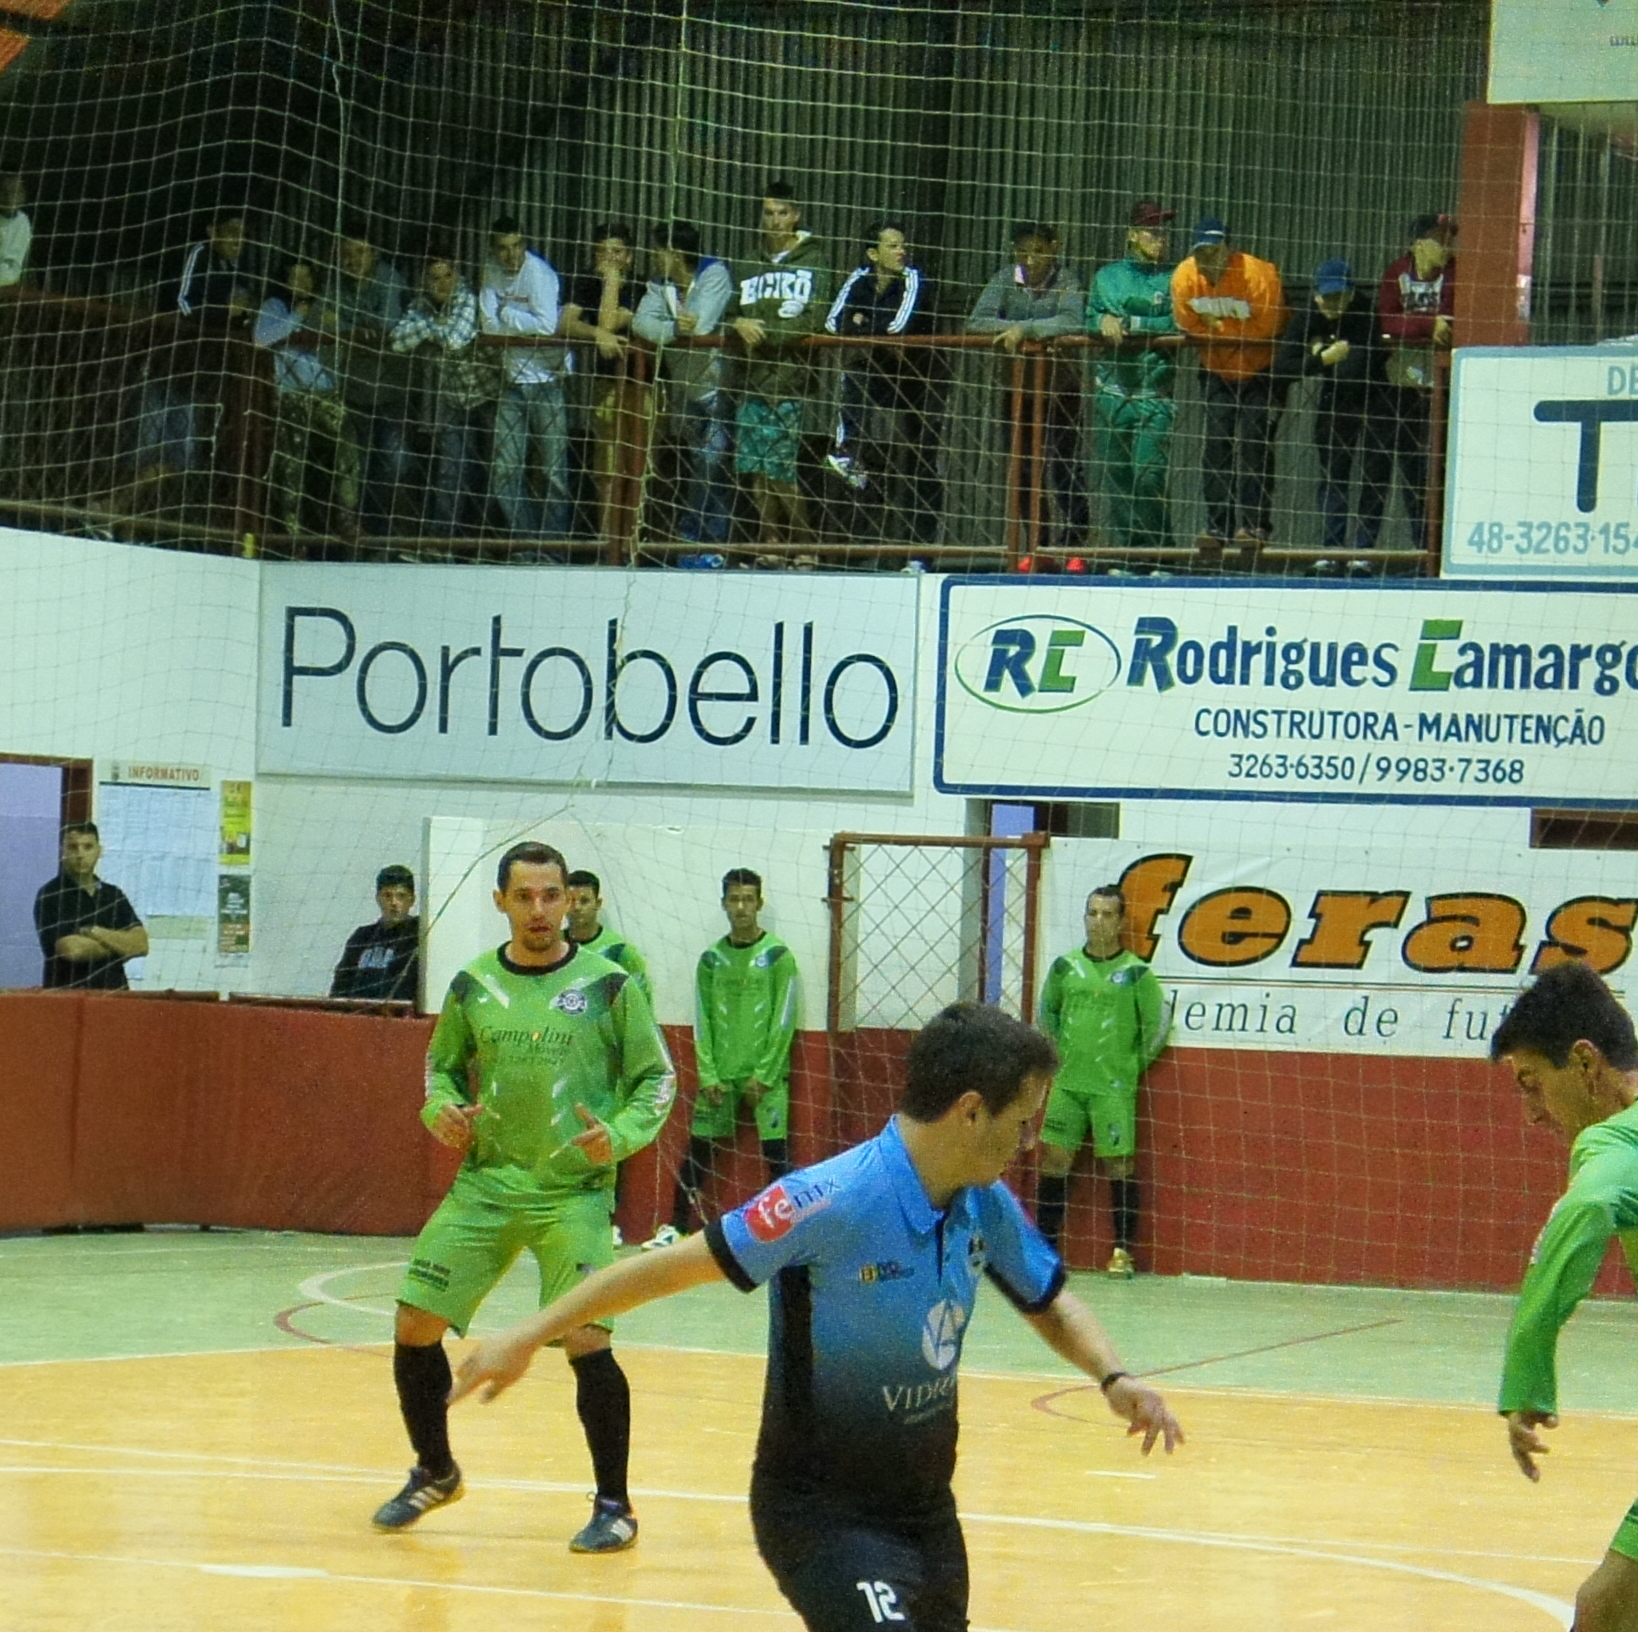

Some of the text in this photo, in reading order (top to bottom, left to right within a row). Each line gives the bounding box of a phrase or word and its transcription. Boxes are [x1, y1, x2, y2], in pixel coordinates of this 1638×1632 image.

[1127, 616, 1398, 693] Rodrigues
[278, 605, 899, 750] Portobello
[1193, 707, 1400, 742] CONSTRUTORA
[1417, 708, 1606, 747] MANUTENÇÃO
[128, 765, 200, 782] INFORMATIVO
[1343, 996, 1400, 1037] de
[856, 1580, 906, 1624] 12
